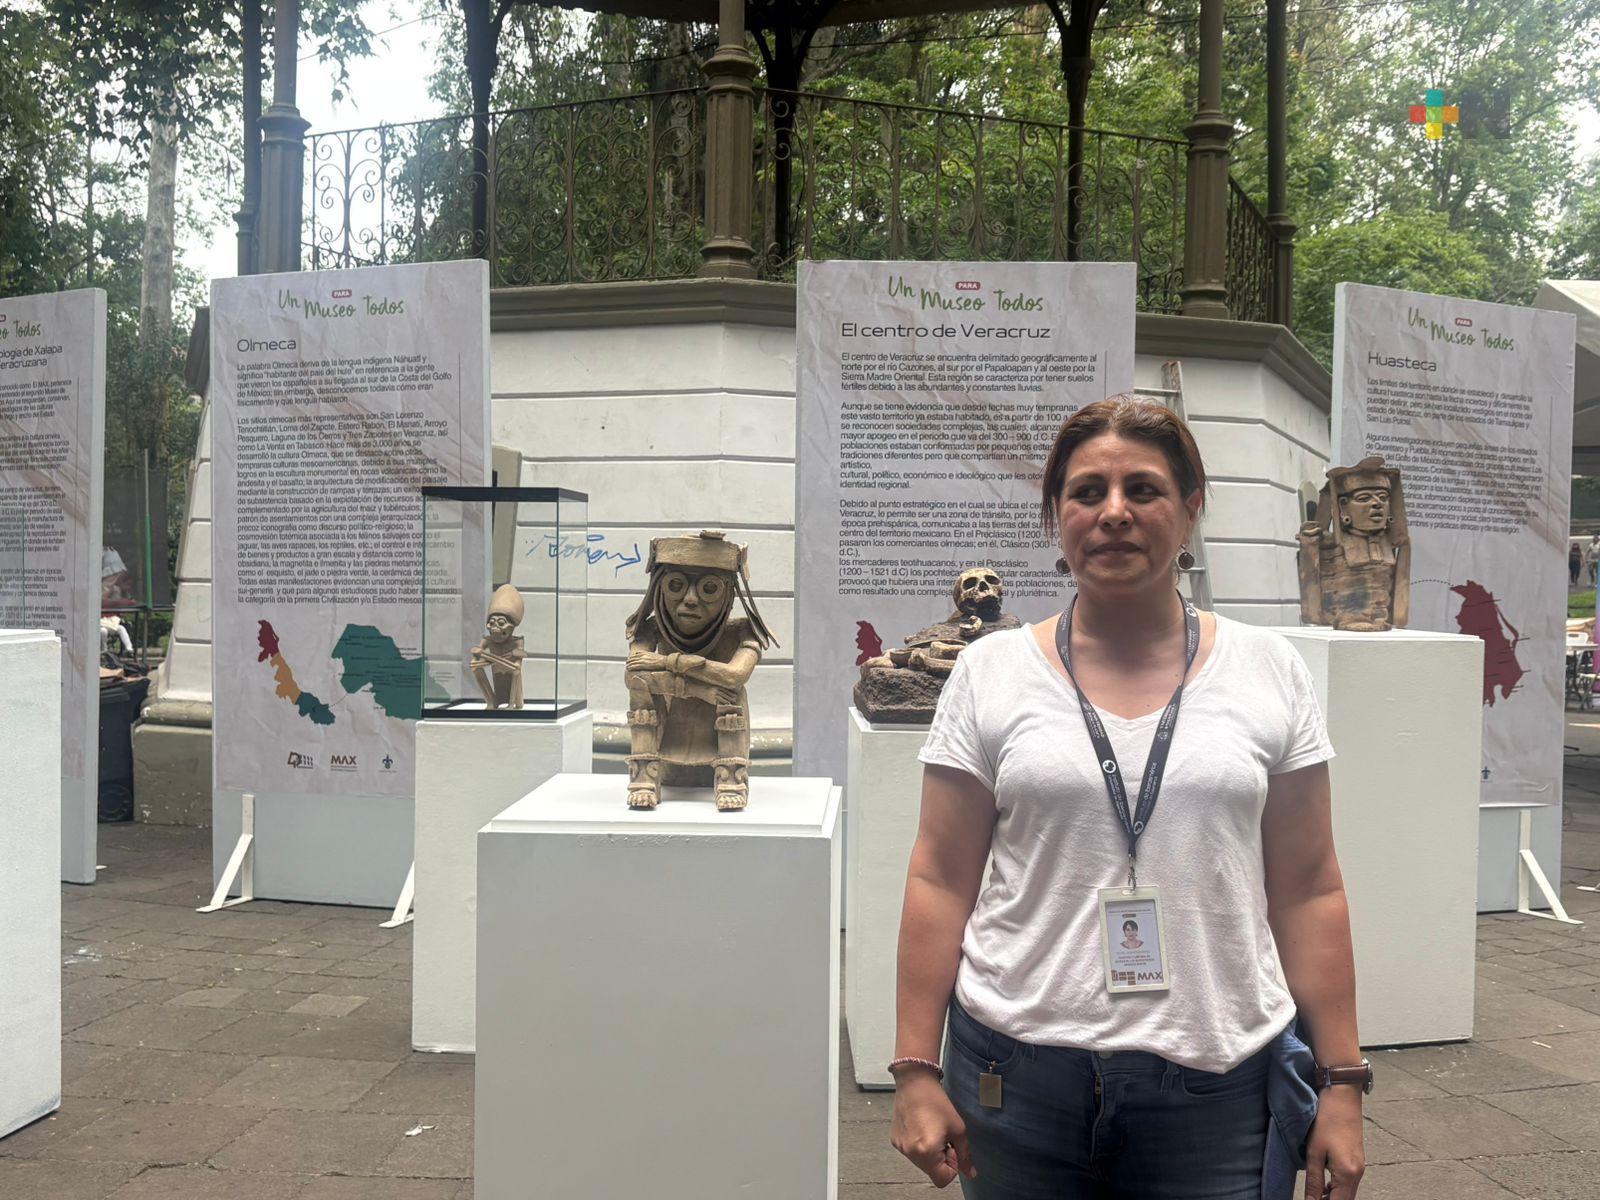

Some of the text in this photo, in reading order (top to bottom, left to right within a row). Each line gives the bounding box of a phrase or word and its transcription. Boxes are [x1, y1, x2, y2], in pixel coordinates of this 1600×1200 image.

[889, 276, 915, 298] Un
[921, 288, 985, 311] Museo
[994, 290, 1043, 311] Todos
[279, 289, 300, 309] Un
[305, 298, 356, 318] Museo
[363, 296, 404, 315] Todos
[13, 319, 41, 338] Todos
[842, 323, 1050, 338] El centro de Veracruz
[1408, 307, 1427, 328] Un
[1431, 320, 1476, 346] Museo
[1481, 328, 1514, 351] Todos
[237, 339, 296, 352] Olmeca
[23, 347, 33, 356] de
[842, 353, 849, 361] El
[850, 353, 876, 361] centro
[877, 353, 888, 361] de
[889, 353, 924, 361] Veracruz
[936, 353, 976, 362] encuentra
[978, 354, 1019, 362] delimitado
[1020, 354, 1088, 364] geográficamente
[1089, 354, 1096, 362] al
[1368, 352, 1436, 372] Huasteca
[0, 359, 48, 370] eracruzana
[842, 362, 862, 371] norte
[878, 363, 885, 371] el
[937, 363, 945, 371] al
[975, 363, 983, 371] el
[984, 363, 1032, 373] Papaloapan
[1039, 364, 1047, 372] al
[1048, 364, 1071, 372] oeste
[1087, 364, 1095, 372] la
[841, 372, 865, 381] Sierra
[866, 372, 892, 381] Madre
[927, 373, 945, 381] Esta
[985, 373, 1028, 381] caracteriza
[1045, 373, 1066, 381] tener
[1067, 373, 1093, 382] suelos
[841, 382, 867, 390] fértiles
[868, 382, 896, 390] debido
[903, 382, 916, 391] las
[917, 382, 964, 391] abundantes
[972, 383, 1016, 391] constantes
[1017, 383, 1043, 391] lluvias.
[841, 402, 872, 412] Aunque
[884, 402, 904, 411] tiene
[905, 403, 943, 411] evidencia
[961, 403, 986, 411] desde
[988, 403, 1015, 411] fechas
[1035, 403, 1078, 413] tempranas
[840, 500, 868, 508] Debido
[869, 500, 877, 508] al
[878, 500, 901, 510] punto
[902, 500, 945, 510] estratégico
[958, 500, 966, 508] el
[967, 500, 984, 508] cual
[997, 500, 1019, 508] ubica
[1020, 500, 1028, 508] el
[839, 528, 864, 537] centro
[865, 529, 878, 537] del
[879, 529, 911, 537] territorio
[953, 529, 965, 538] En
[966, 529, 973, 538] el
[974, 529, 1016, 538] Preclásico
[1017, 530, 1040, 540] (1200
[1138, 972, 1162, 980] MAX
